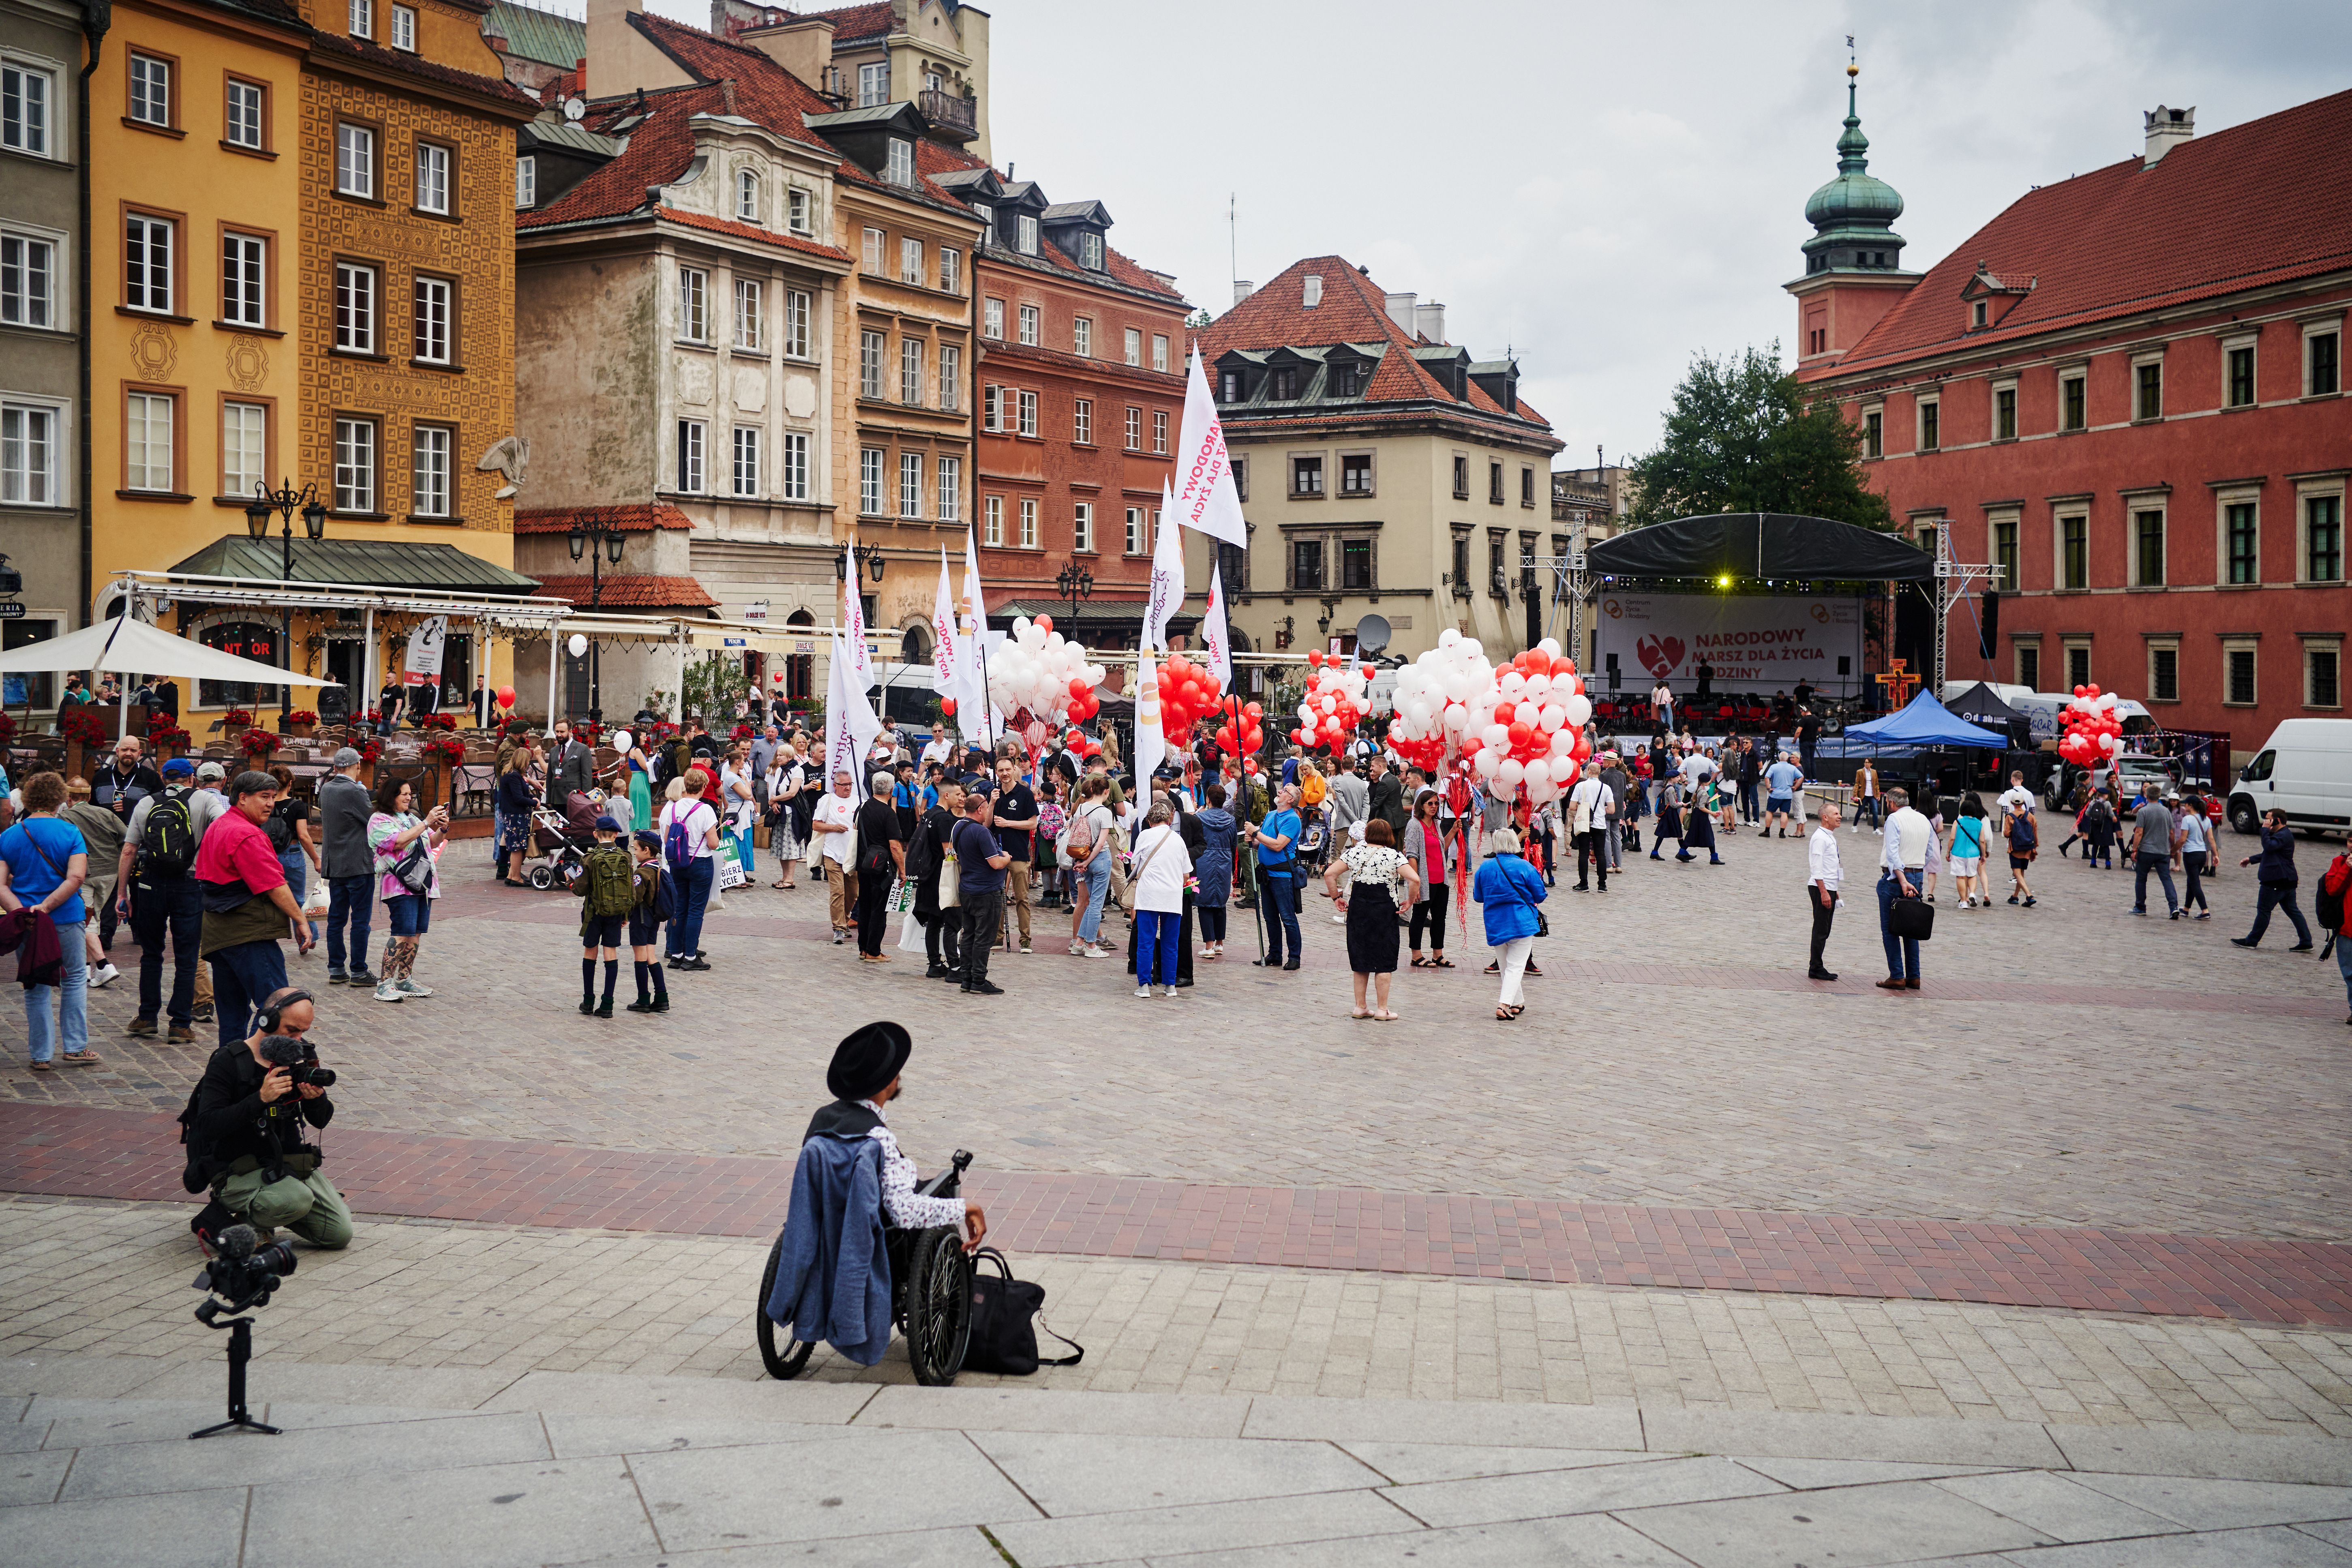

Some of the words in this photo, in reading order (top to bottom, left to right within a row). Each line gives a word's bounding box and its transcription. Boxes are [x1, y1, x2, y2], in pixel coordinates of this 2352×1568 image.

[1331, 639, 1340, 651] LODY
[1696, 628, 1806, 647] NARODOWY
[1692, 651, 1744, 662] MARSZ
[1748, 649, 1777, 661] DLA
[1781, 646, 1825, 660] ŻYCIA
[936, 652, 950, 679] ŻYCIA
[1686, 666, 1689, 677] I
[892, 887, 901, 910] YBIERZ
